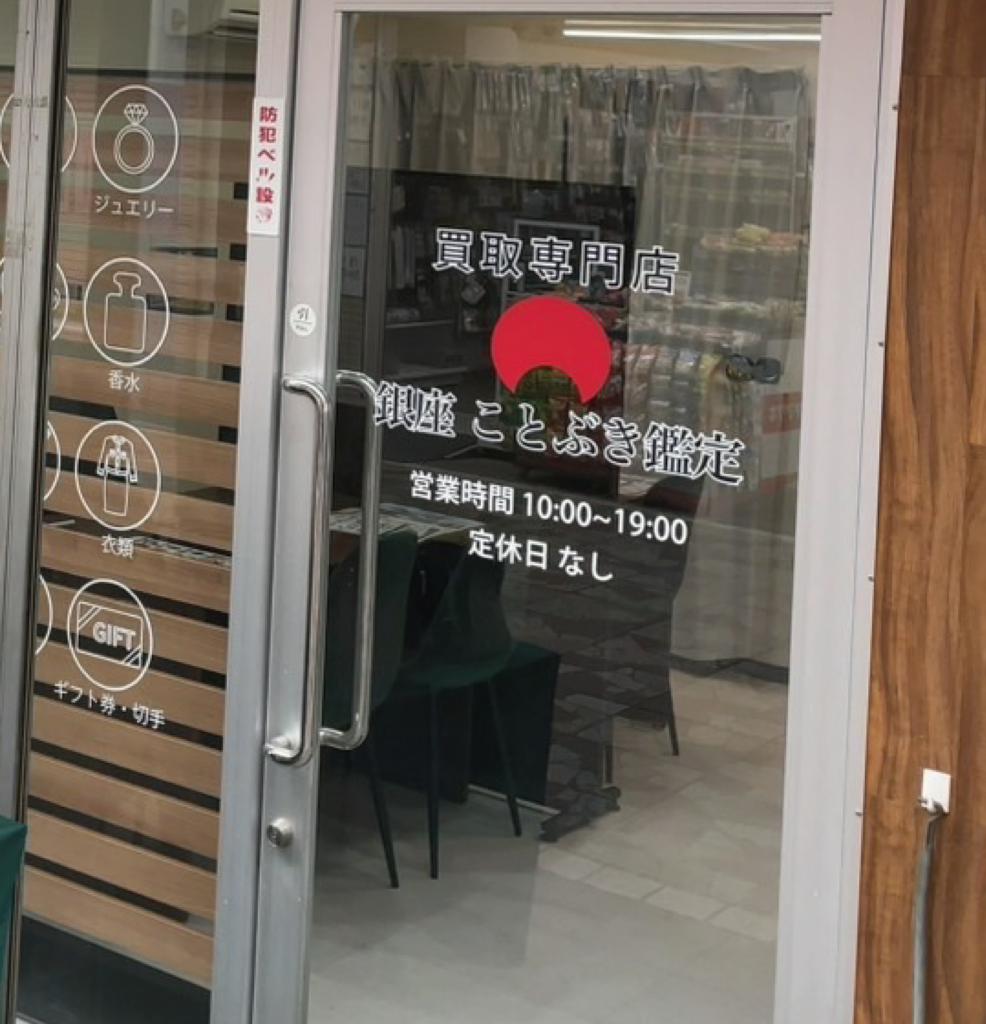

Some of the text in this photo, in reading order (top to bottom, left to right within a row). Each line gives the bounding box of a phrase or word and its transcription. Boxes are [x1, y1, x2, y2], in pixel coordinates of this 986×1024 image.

[94, 194, 174, 219] ジュエリー
[432, 227, 680, 296] 買取専門店
[108, 370, 141, 393] 香水
[373, 381, 746, 486] 銀座 ことぶき鑑定
[410, 470, 514, 516] 営業時間
[102, 535, 135, 559] 衣類
[468, 529, 614, 581] 定休日 なし
[93, 621, 137, 649] GIFT
[54, 681, 166, 729] ギフト券・切手
